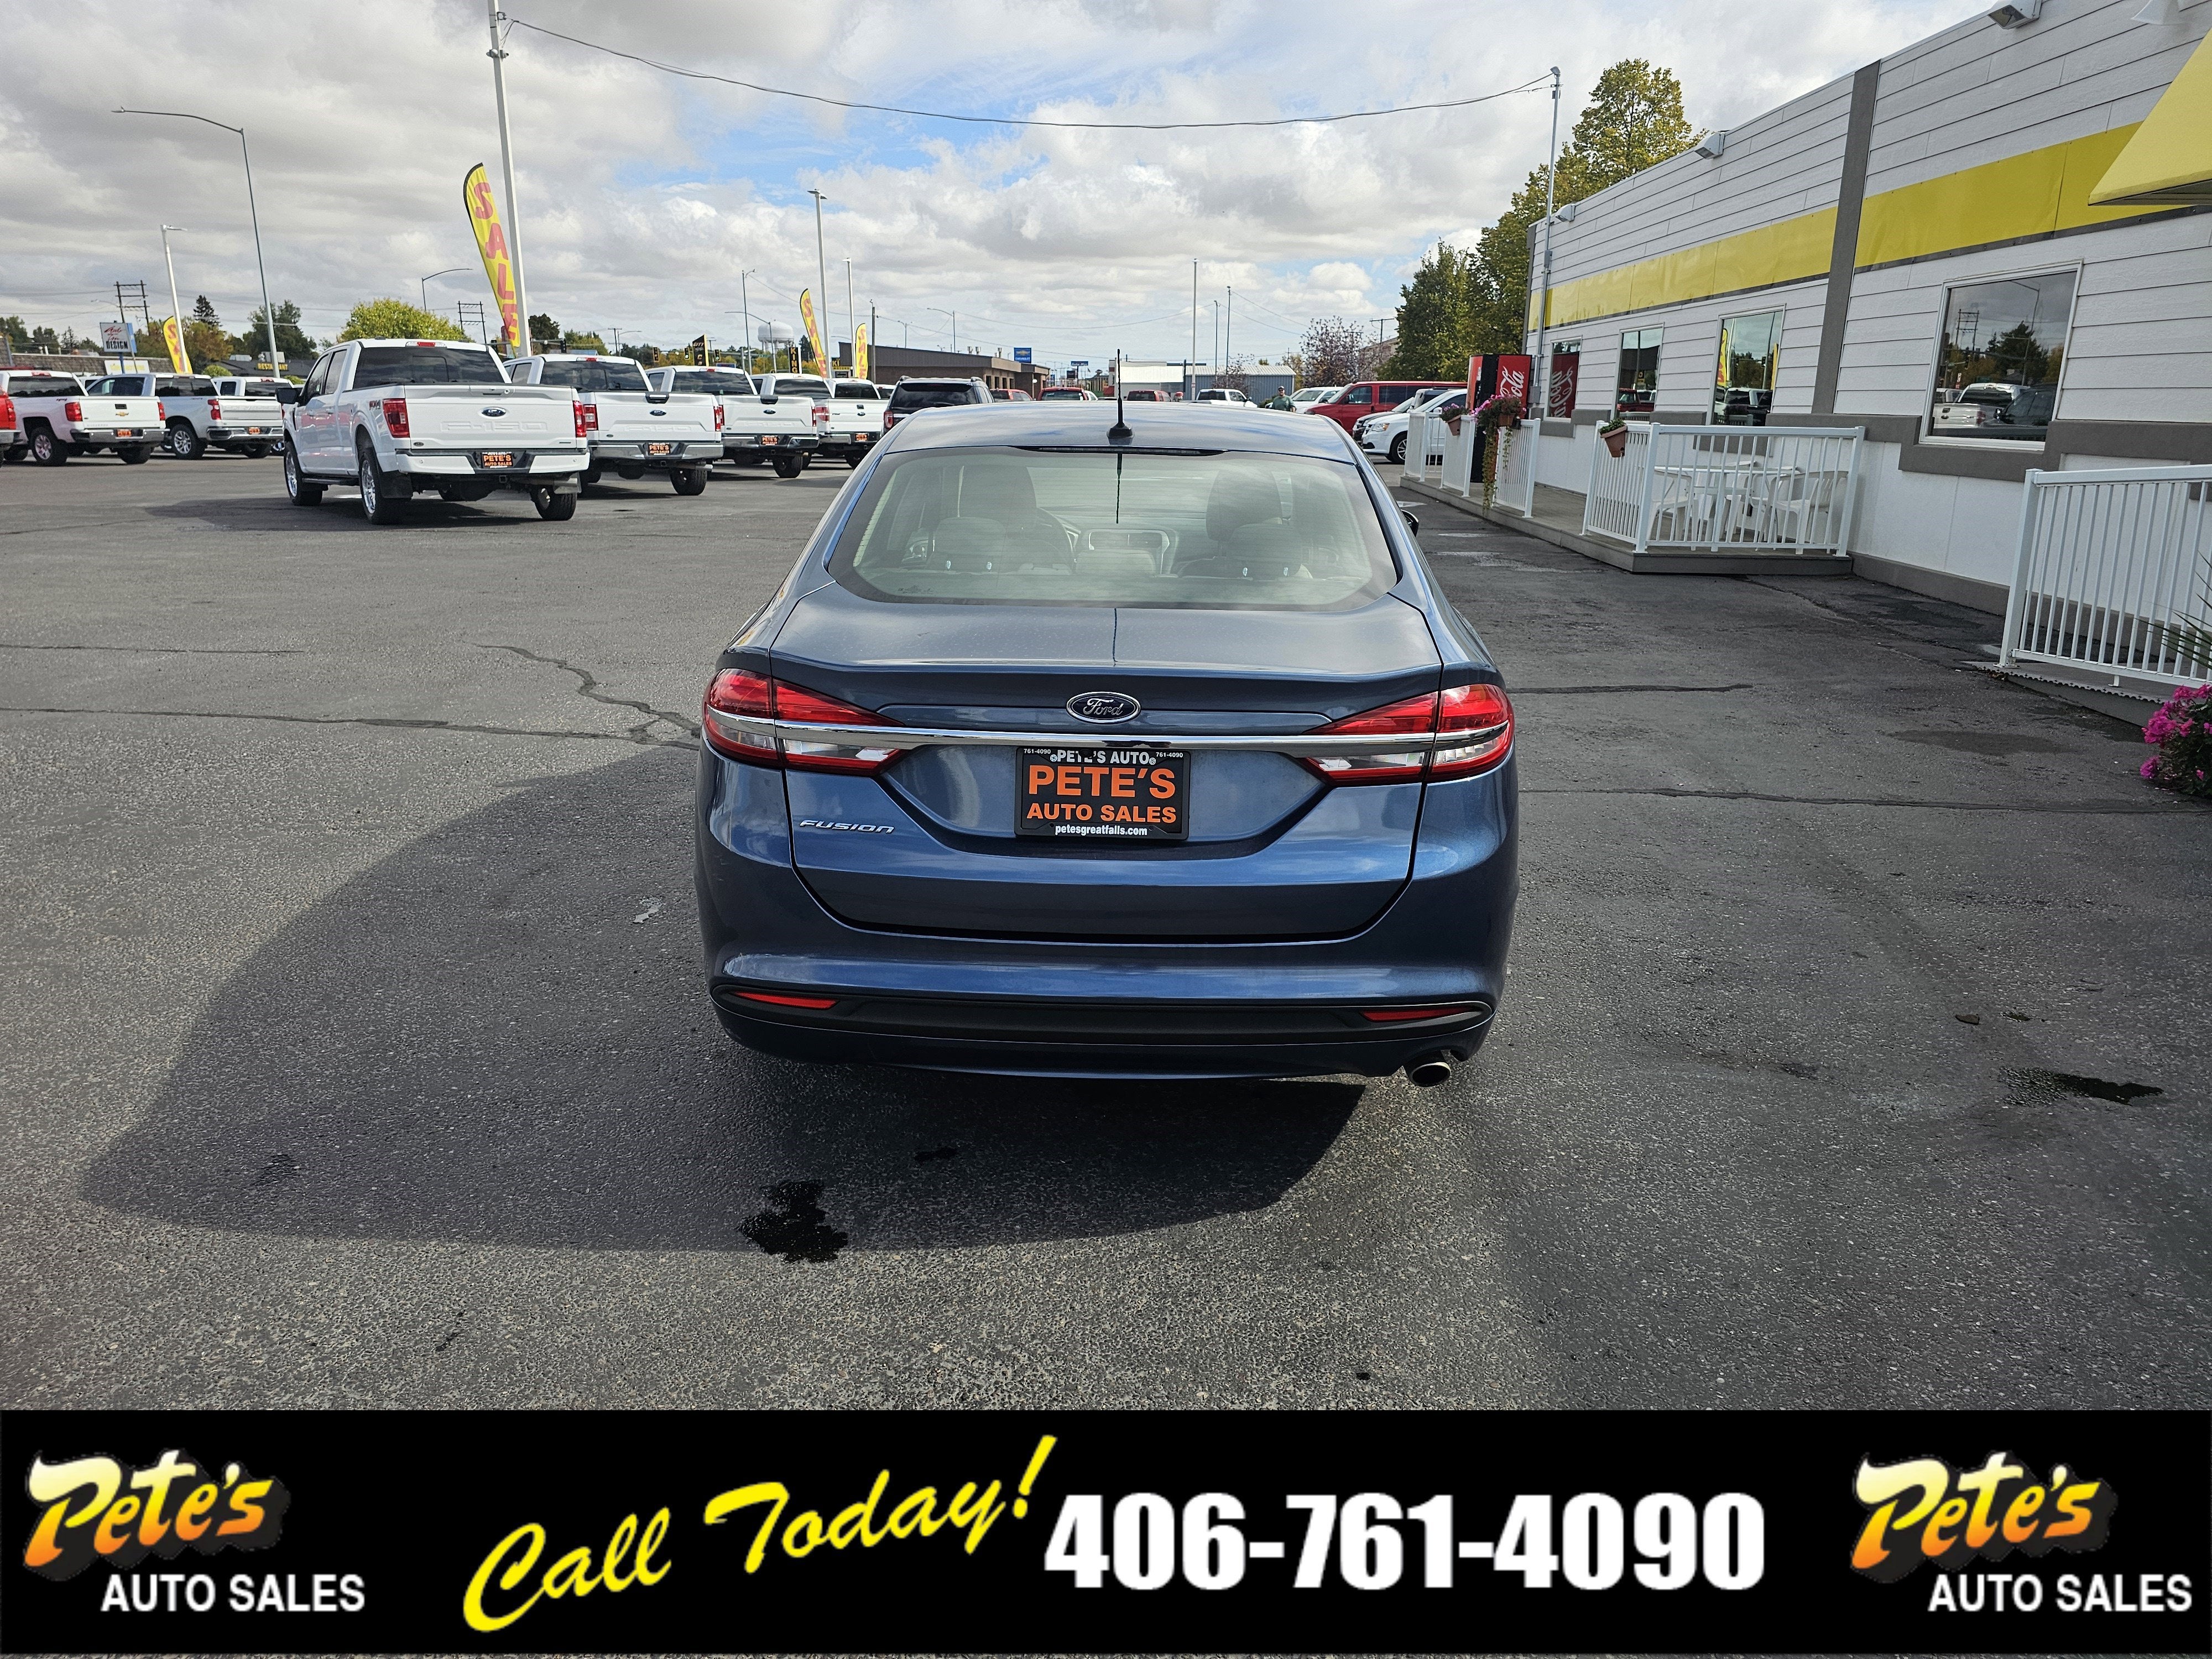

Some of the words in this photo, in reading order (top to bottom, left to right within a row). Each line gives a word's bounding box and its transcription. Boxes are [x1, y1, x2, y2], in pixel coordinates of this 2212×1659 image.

[474, 182, 518, 341] SALE
[106, 341, 128, 349] DESIGN
[441, 422, 547, 431] F-150
[1083, 698, 1124, 716] Ford
[1110, 751, 1150, 765] AUTO
[1029, 765, 1176, 799] PETE'S
[1026, 803, 1093, 821] AUTO
[1100, 805, 1177, 823] SALES
[1055, 825, 1147, 836] petesgreatfalls.com
